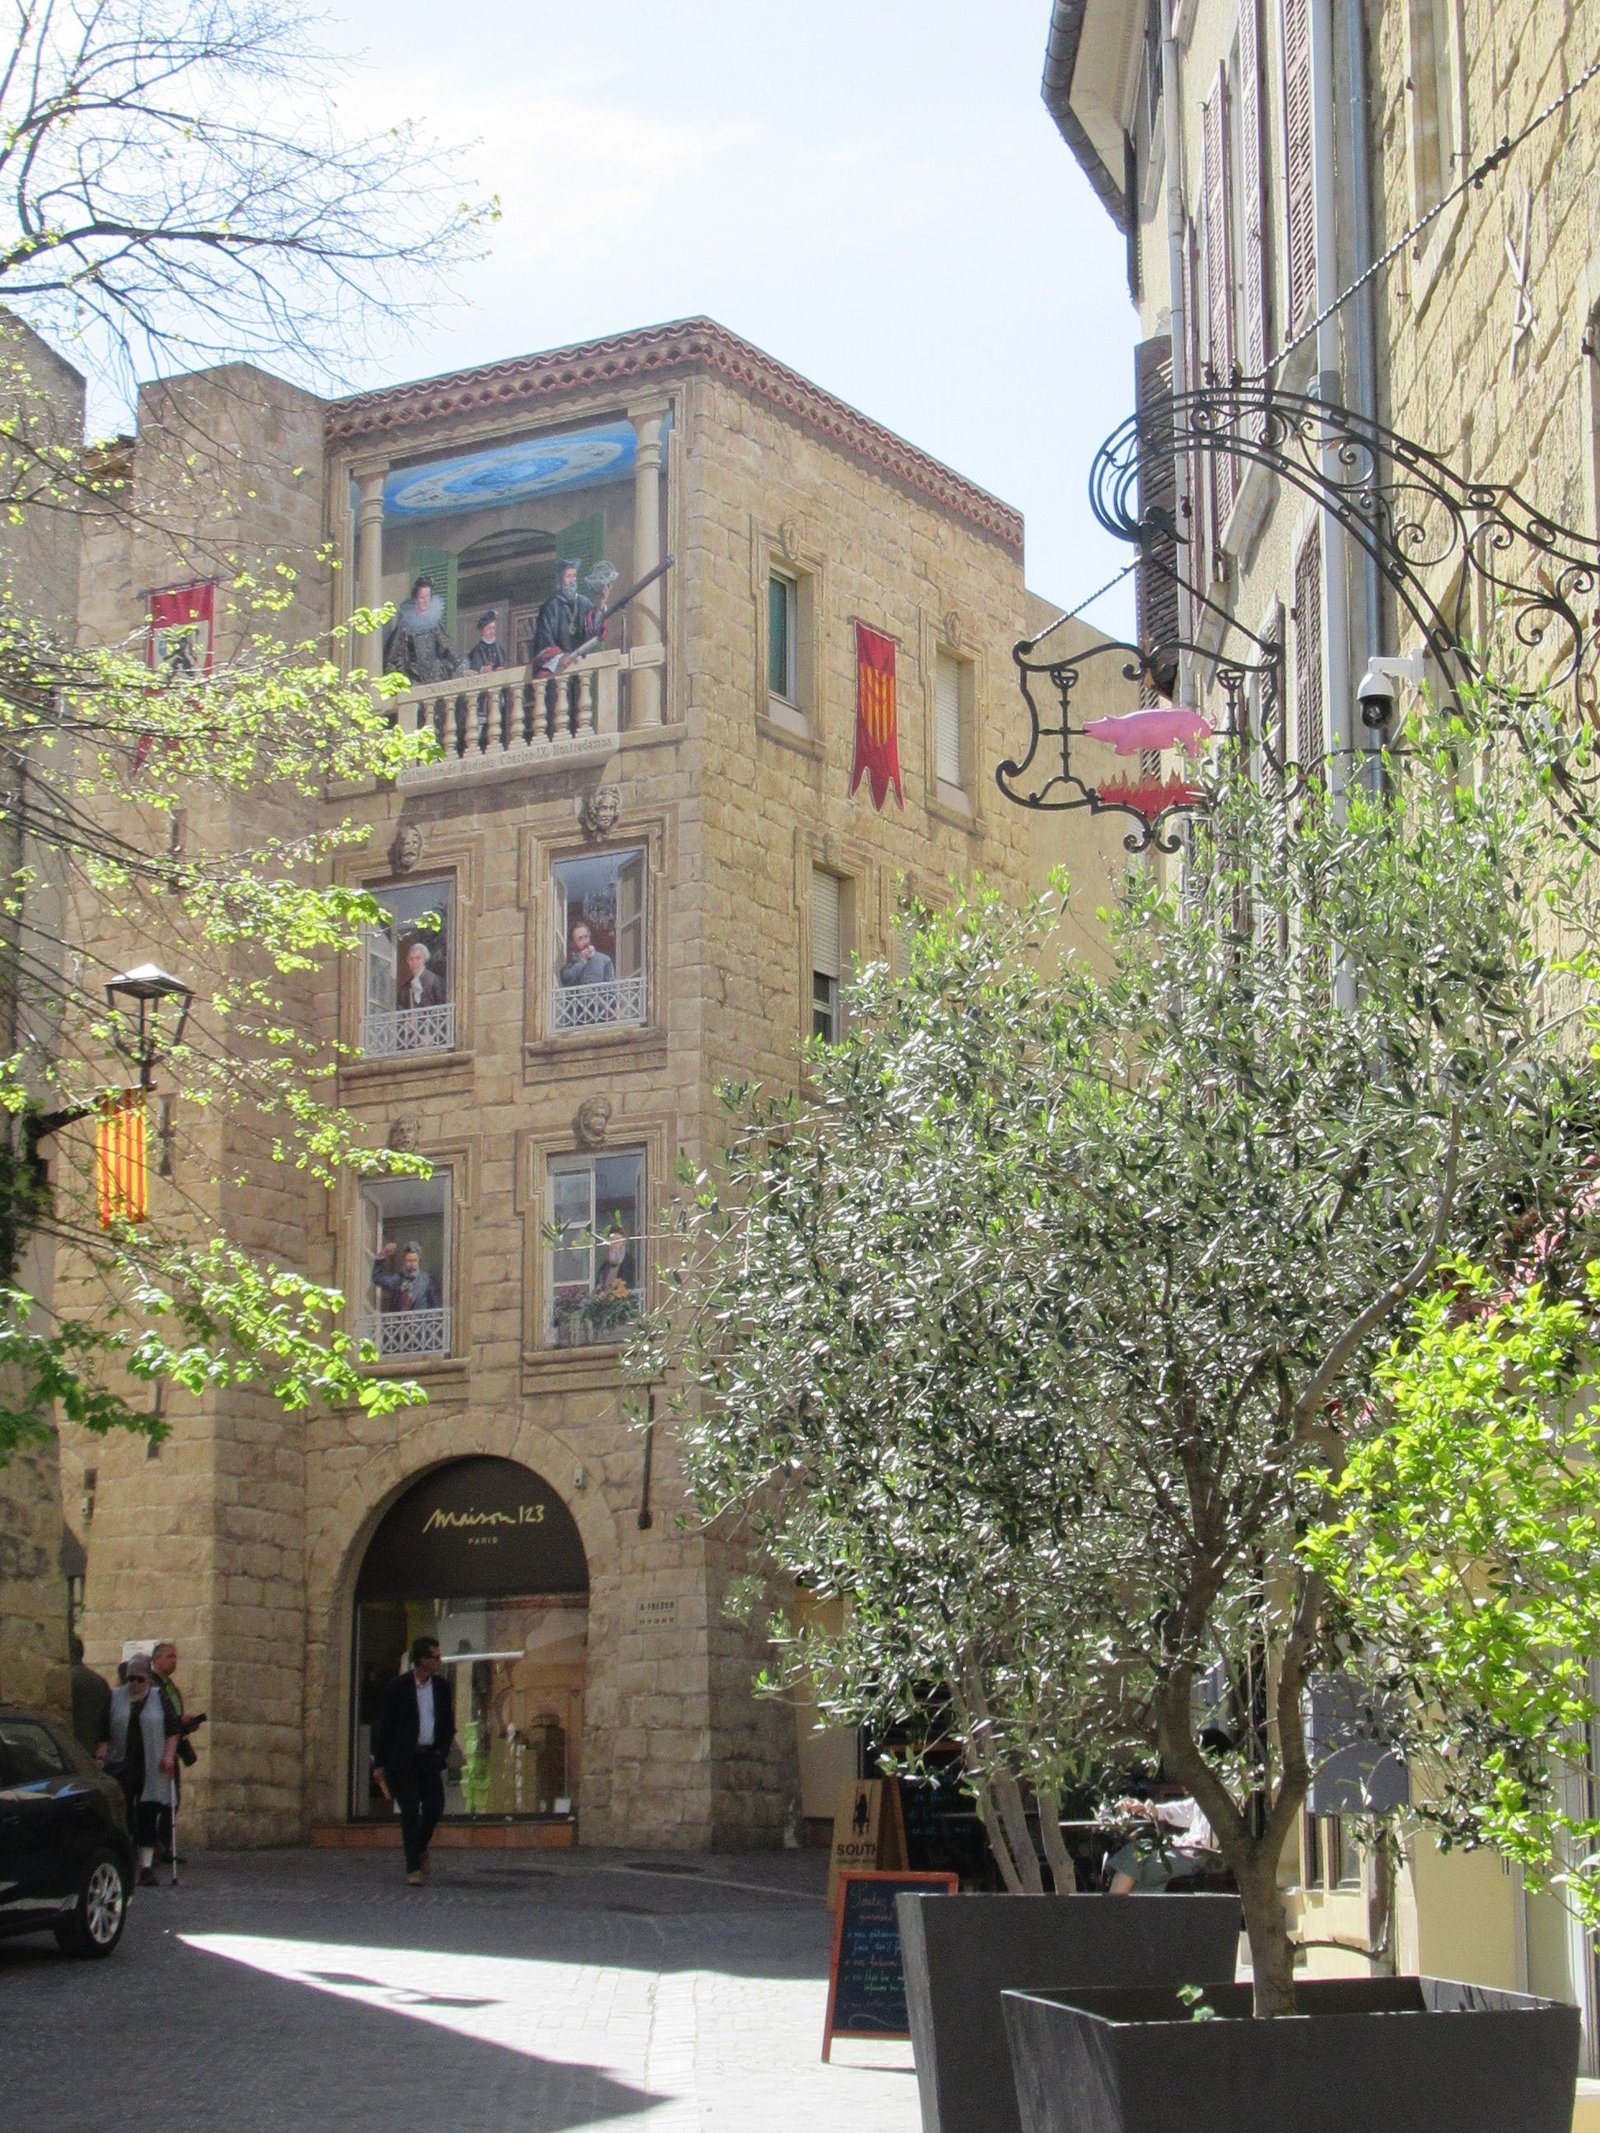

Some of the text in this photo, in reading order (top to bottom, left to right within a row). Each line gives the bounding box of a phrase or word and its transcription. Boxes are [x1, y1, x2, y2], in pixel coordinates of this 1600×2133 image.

[553, 737, 612, 756] Nostradamus
[519, 1504, 546, 1524] 123
[468, 1536, 498, 1545] PARIS
